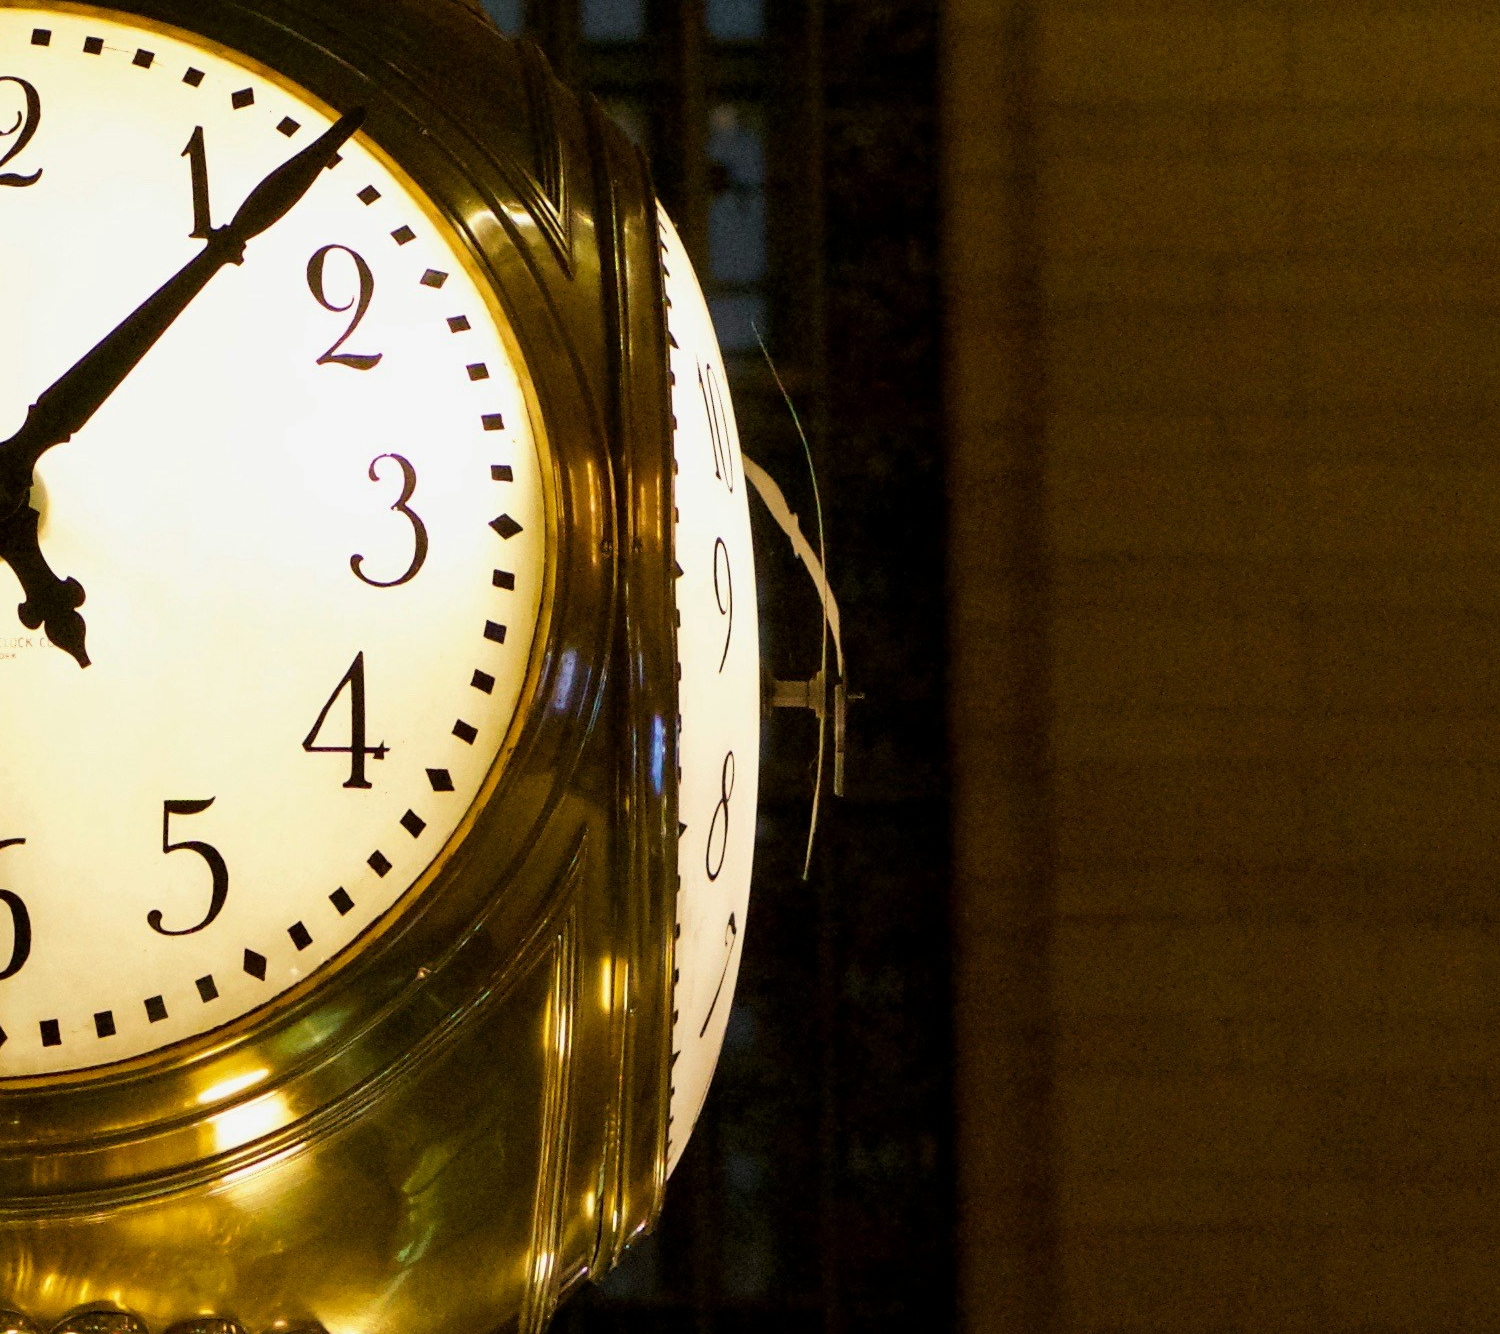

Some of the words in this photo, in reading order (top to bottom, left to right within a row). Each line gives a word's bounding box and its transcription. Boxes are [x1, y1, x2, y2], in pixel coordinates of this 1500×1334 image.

[180, 125, 214, 239] 1
[307, 243, 383, 370] 2
[349, 453, 429, 587] 3
[713, 536, 733, 673] 9
[301, 650, 391, 790] 4
[147, 796, 229, 937] 5
[706, 750, 735, 883] 8
[700, 910, 737, 1039] 7
